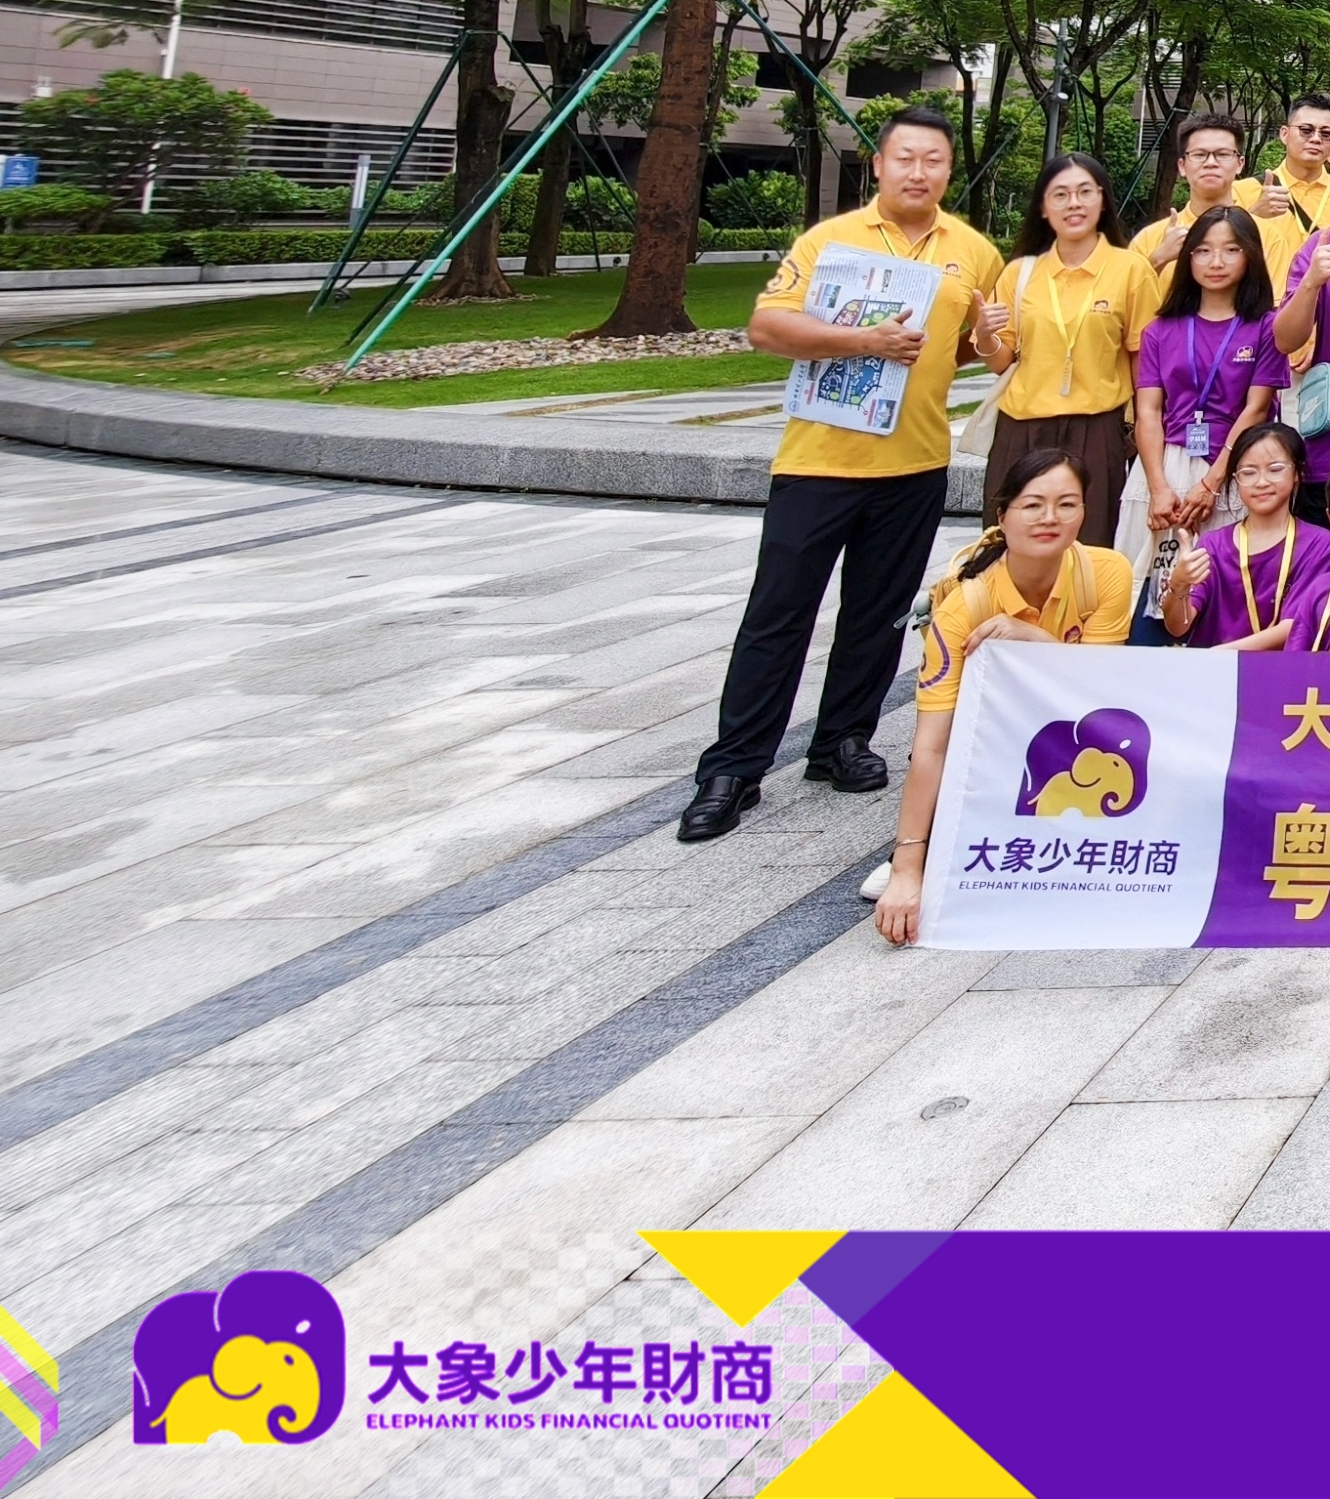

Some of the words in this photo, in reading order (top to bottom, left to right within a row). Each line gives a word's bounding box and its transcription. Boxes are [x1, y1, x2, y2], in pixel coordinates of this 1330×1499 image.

[964, 836, 1181, 876] 大象少年財商
[958, 880, 1018, 891] ELEPHANT
[1021, 881, 1048, 891] KIDS
[1050, 882, 1112, 893] FINANCIAL
[1115, 882, 1173, 893] QUOTIENT
